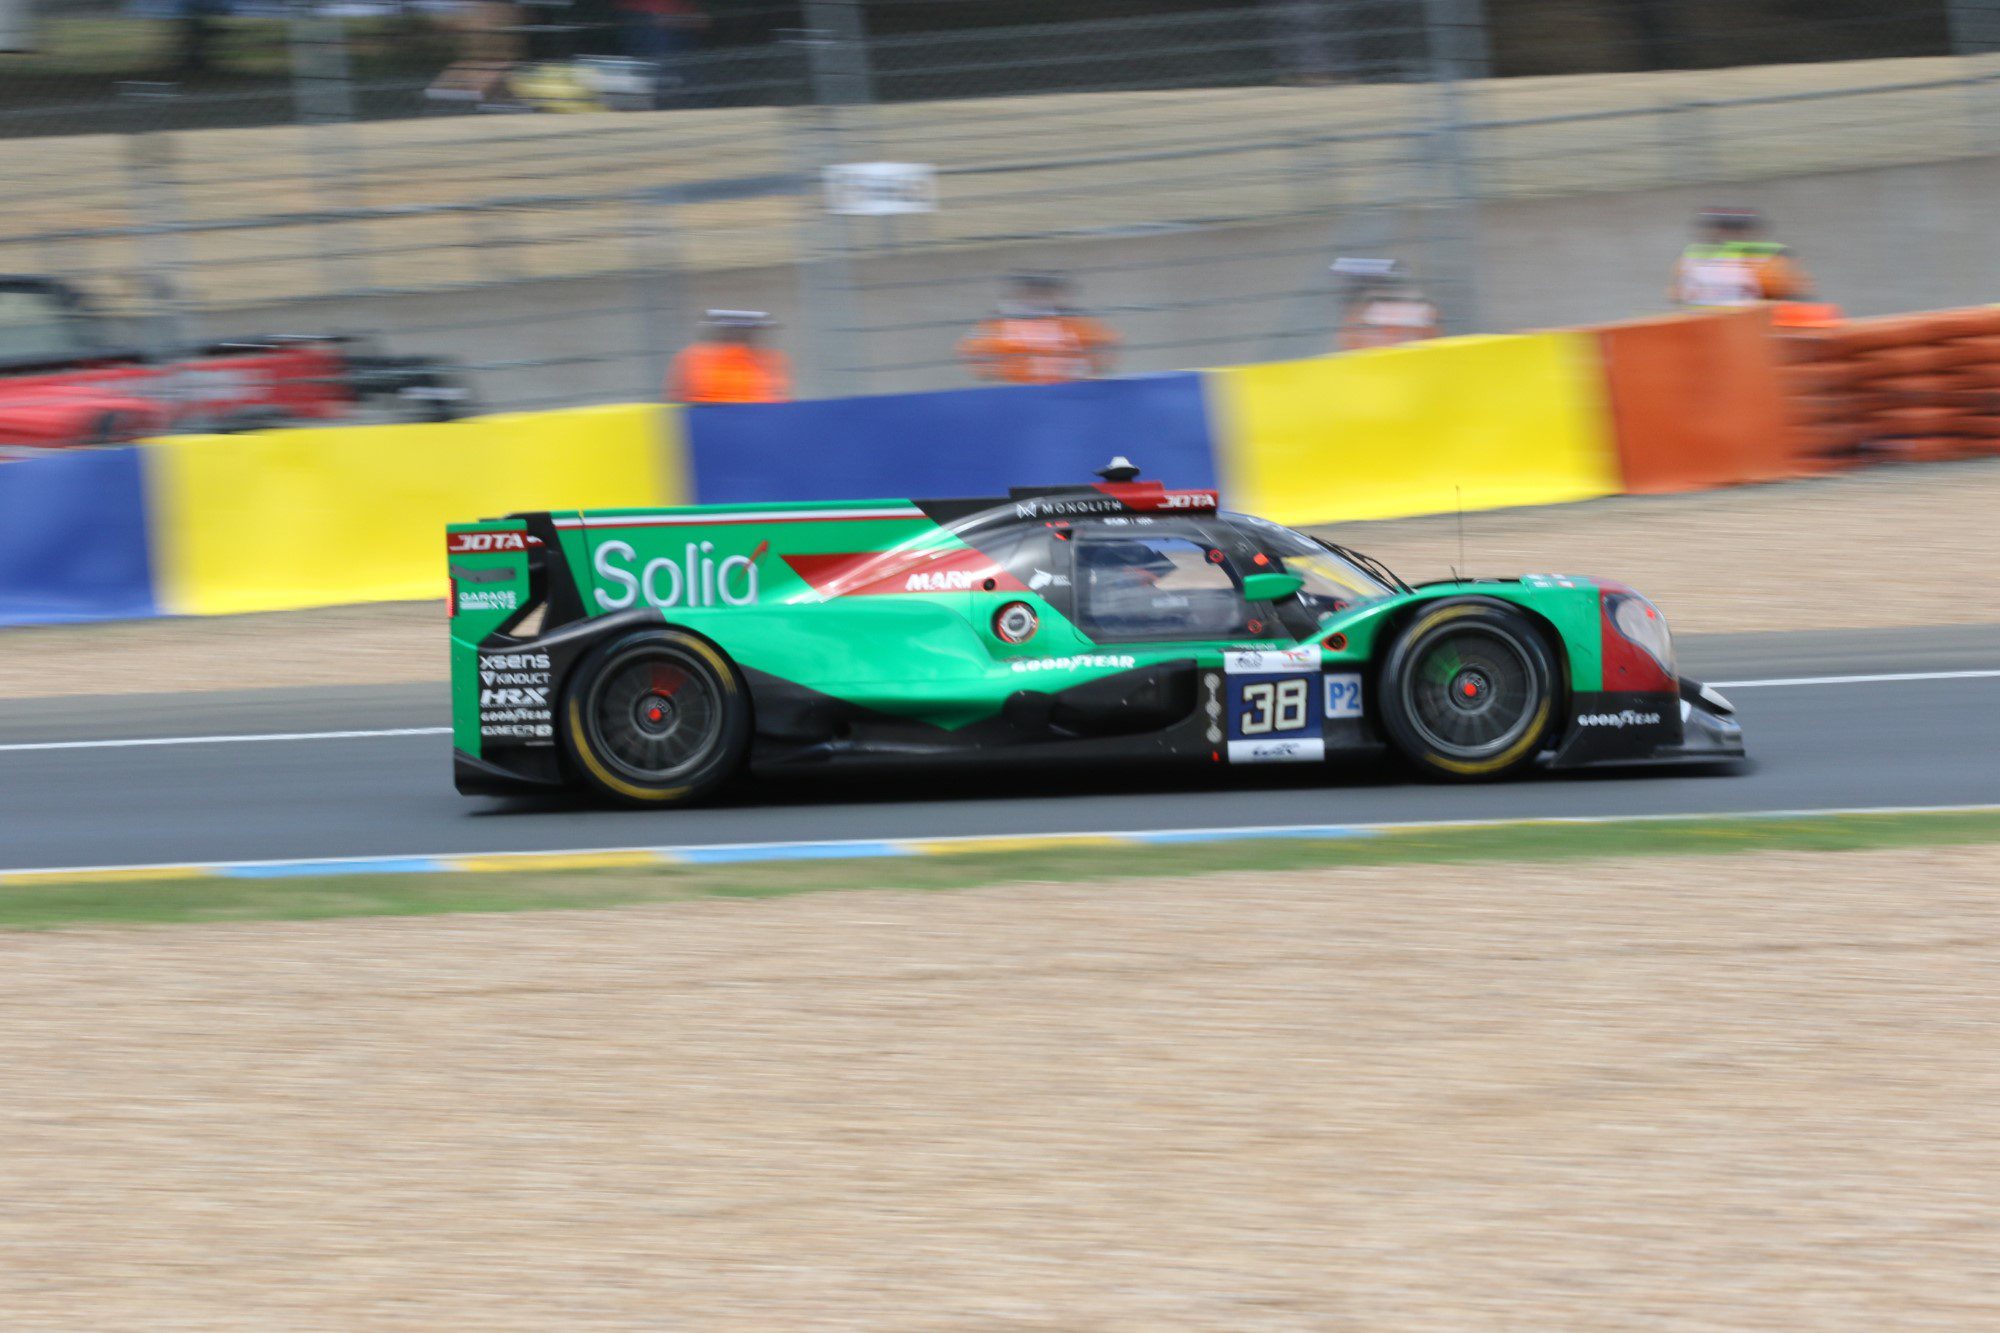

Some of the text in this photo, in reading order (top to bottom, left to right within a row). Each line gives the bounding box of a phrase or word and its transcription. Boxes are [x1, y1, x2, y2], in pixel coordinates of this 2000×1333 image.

[1041, 500, 1123, 515] MONOLITH
[1157, 494, 1216, 509] JOTA
[449, 533, 525, 551] JOTA
[1011, 655, 1136, 672] GOODYEAR
[480, 686, 551, 705] HRX
[1329, 681, 1361, 710] P2
[480, 707, 552, 723] GOODYEAR
[1241, 679, 1308, 735] 38
[1577, 709, 1661, 729] GOODYEAR
